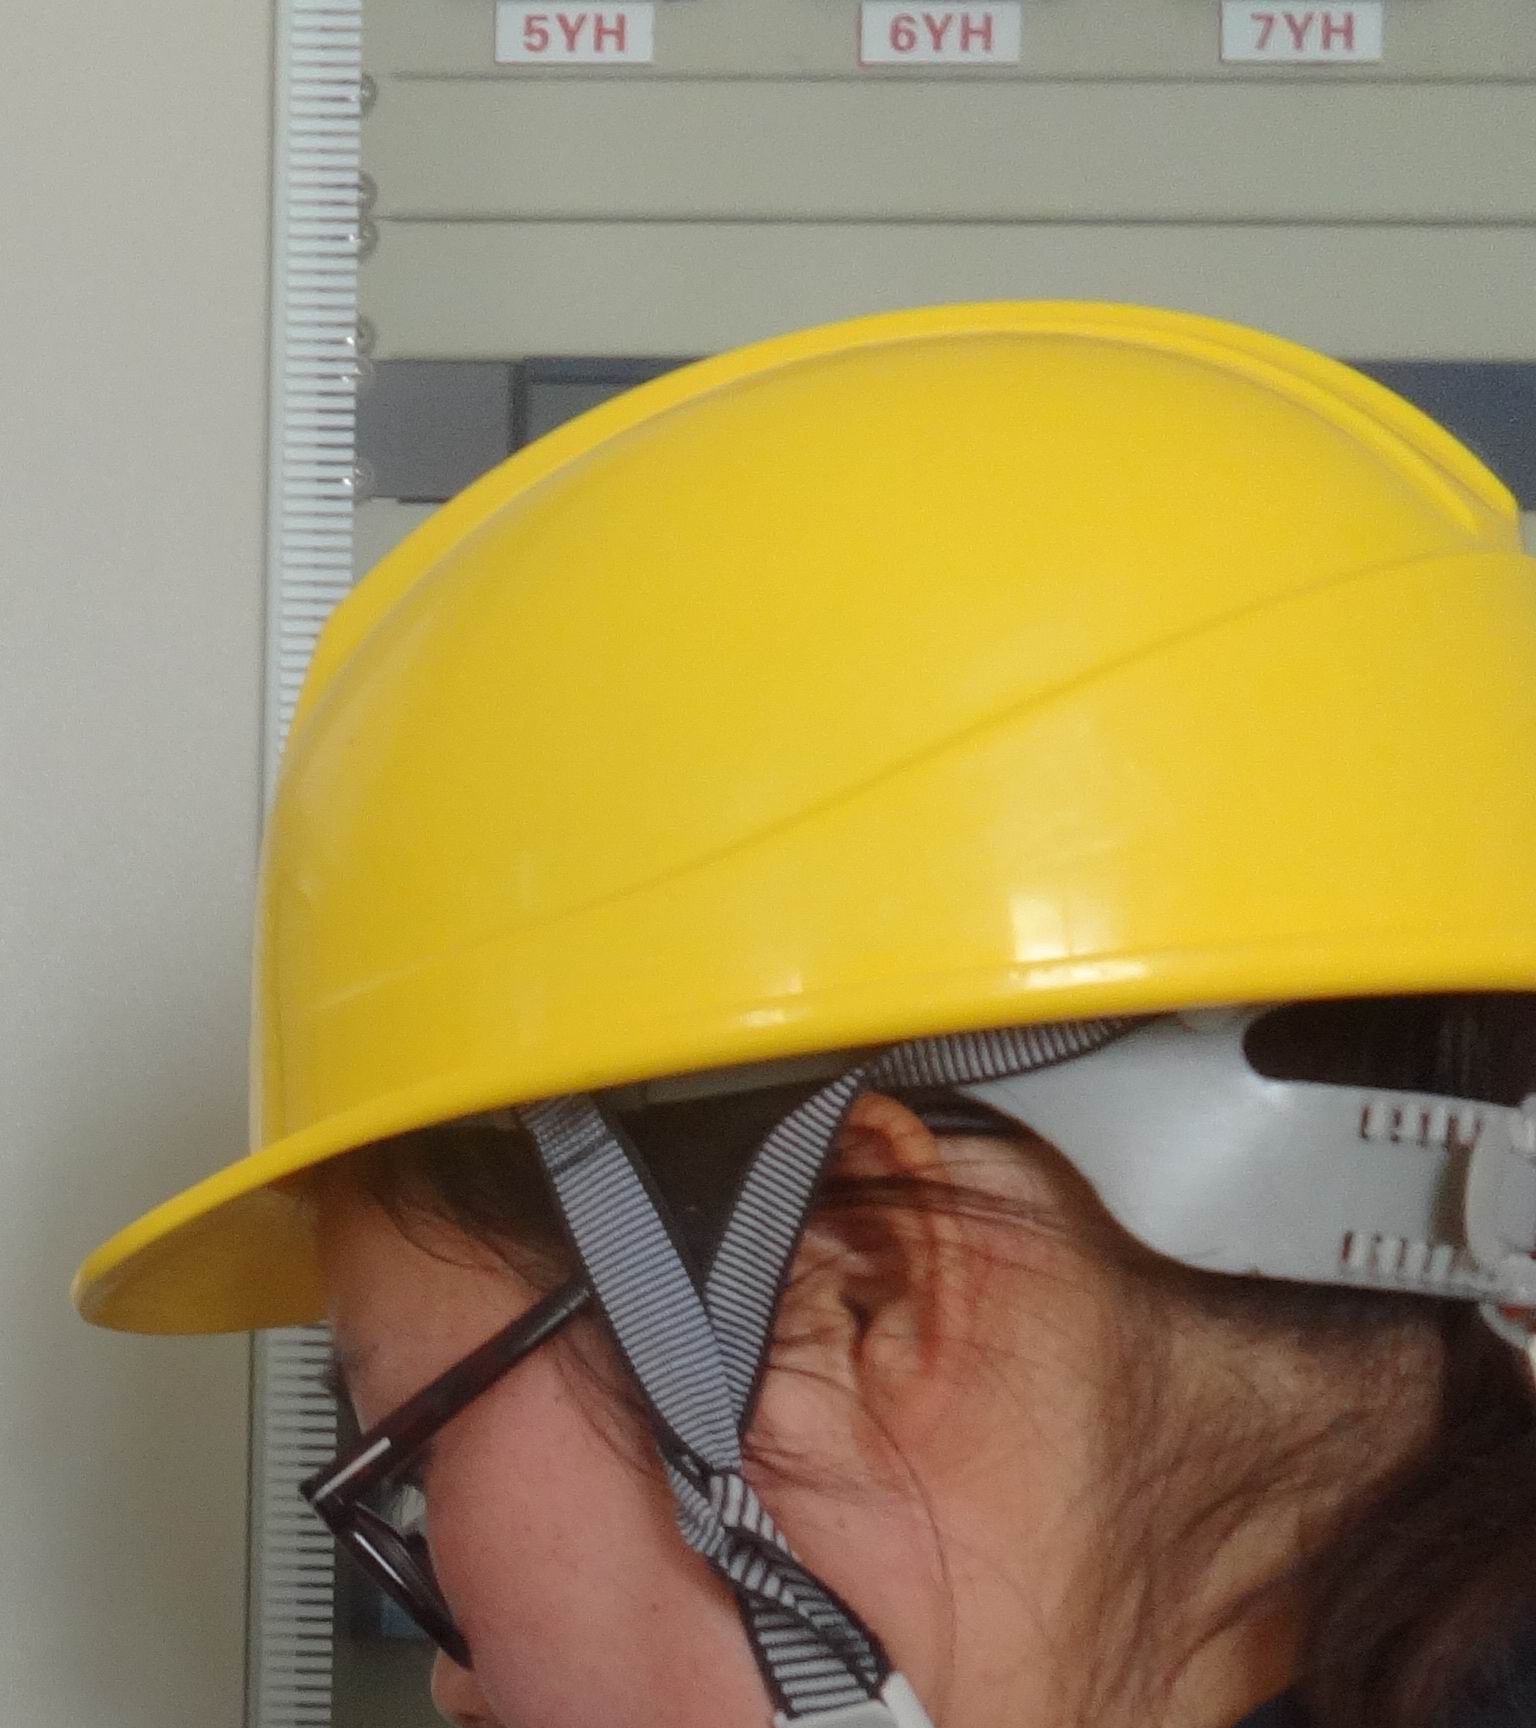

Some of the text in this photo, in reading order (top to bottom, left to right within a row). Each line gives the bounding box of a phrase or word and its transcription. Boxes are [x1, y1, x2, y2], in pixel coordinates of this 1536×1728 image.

[521, 13, 628, 54] 5YH
[888, 13, 996, 54] 6YH
[1249, 12, 1357, 53] 7YH
